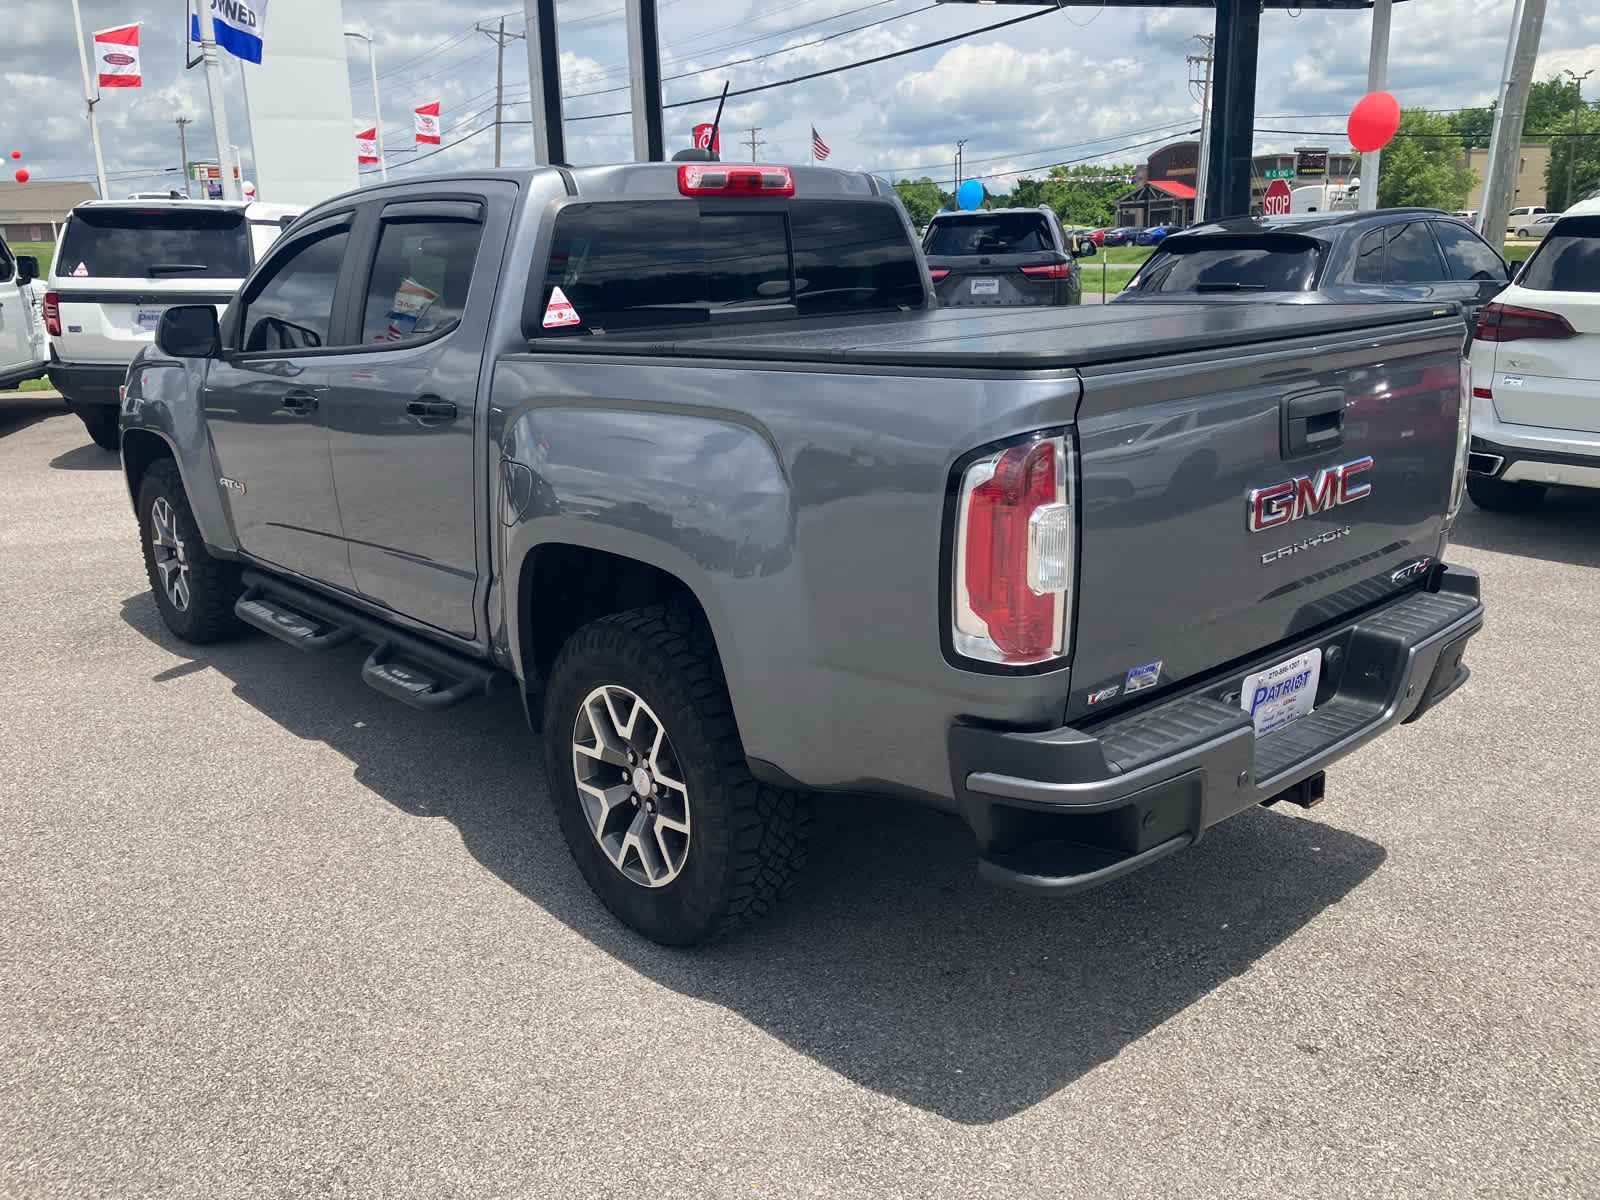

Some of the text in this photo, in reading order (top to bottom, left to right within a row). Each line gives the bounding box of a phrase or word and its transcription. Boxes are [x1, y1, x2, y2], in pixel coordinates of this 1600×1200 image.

[1265, 195, 1290, 216] STOP
[1248, 455, 1374, 533] GMC
[1261, 525, 1351, 564] CANYON
[1250, 670, 1311, 717] PATRIOT
